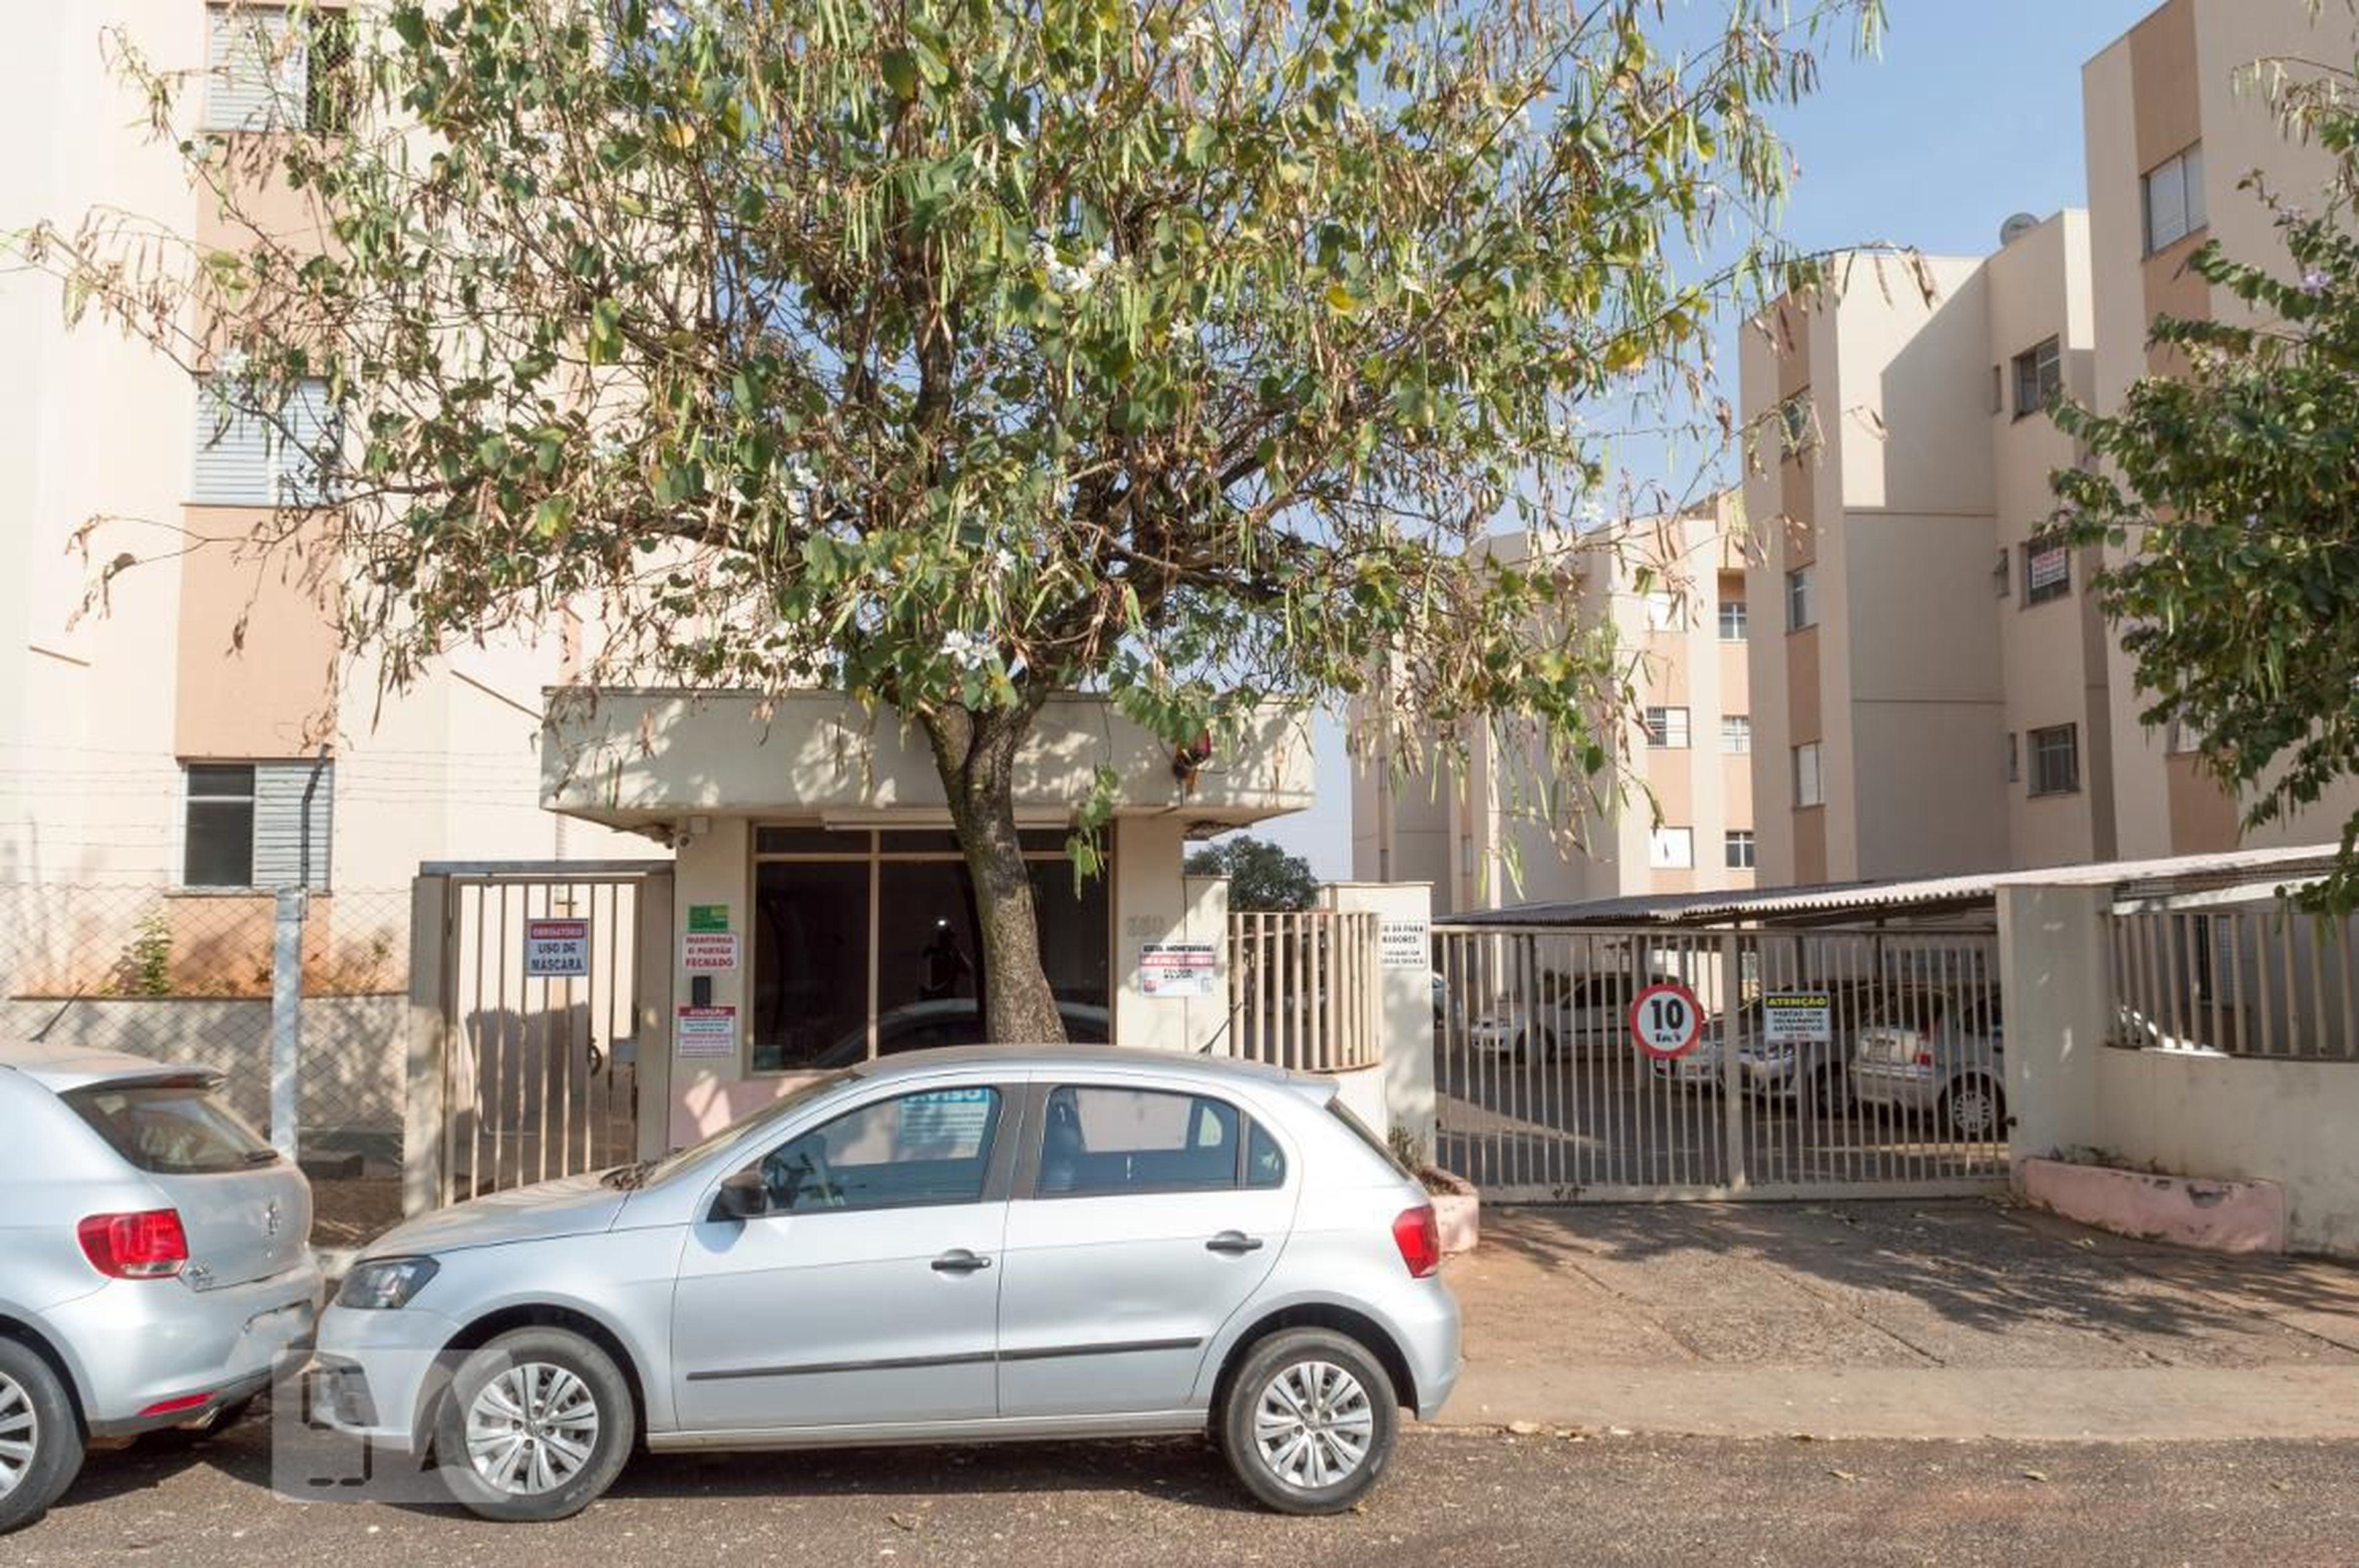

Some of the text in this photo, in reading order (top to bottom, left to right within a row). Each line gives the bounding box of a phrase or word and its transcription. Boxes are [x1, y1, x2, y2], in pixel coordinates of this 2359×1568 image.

[538, 942, 576, 954] USO DE
[686, 957, 734, 967] FECHADO
[1768, 996, 1826, 1007] ATENÇÃO
[1651, 998, 1684, 1030] 10
